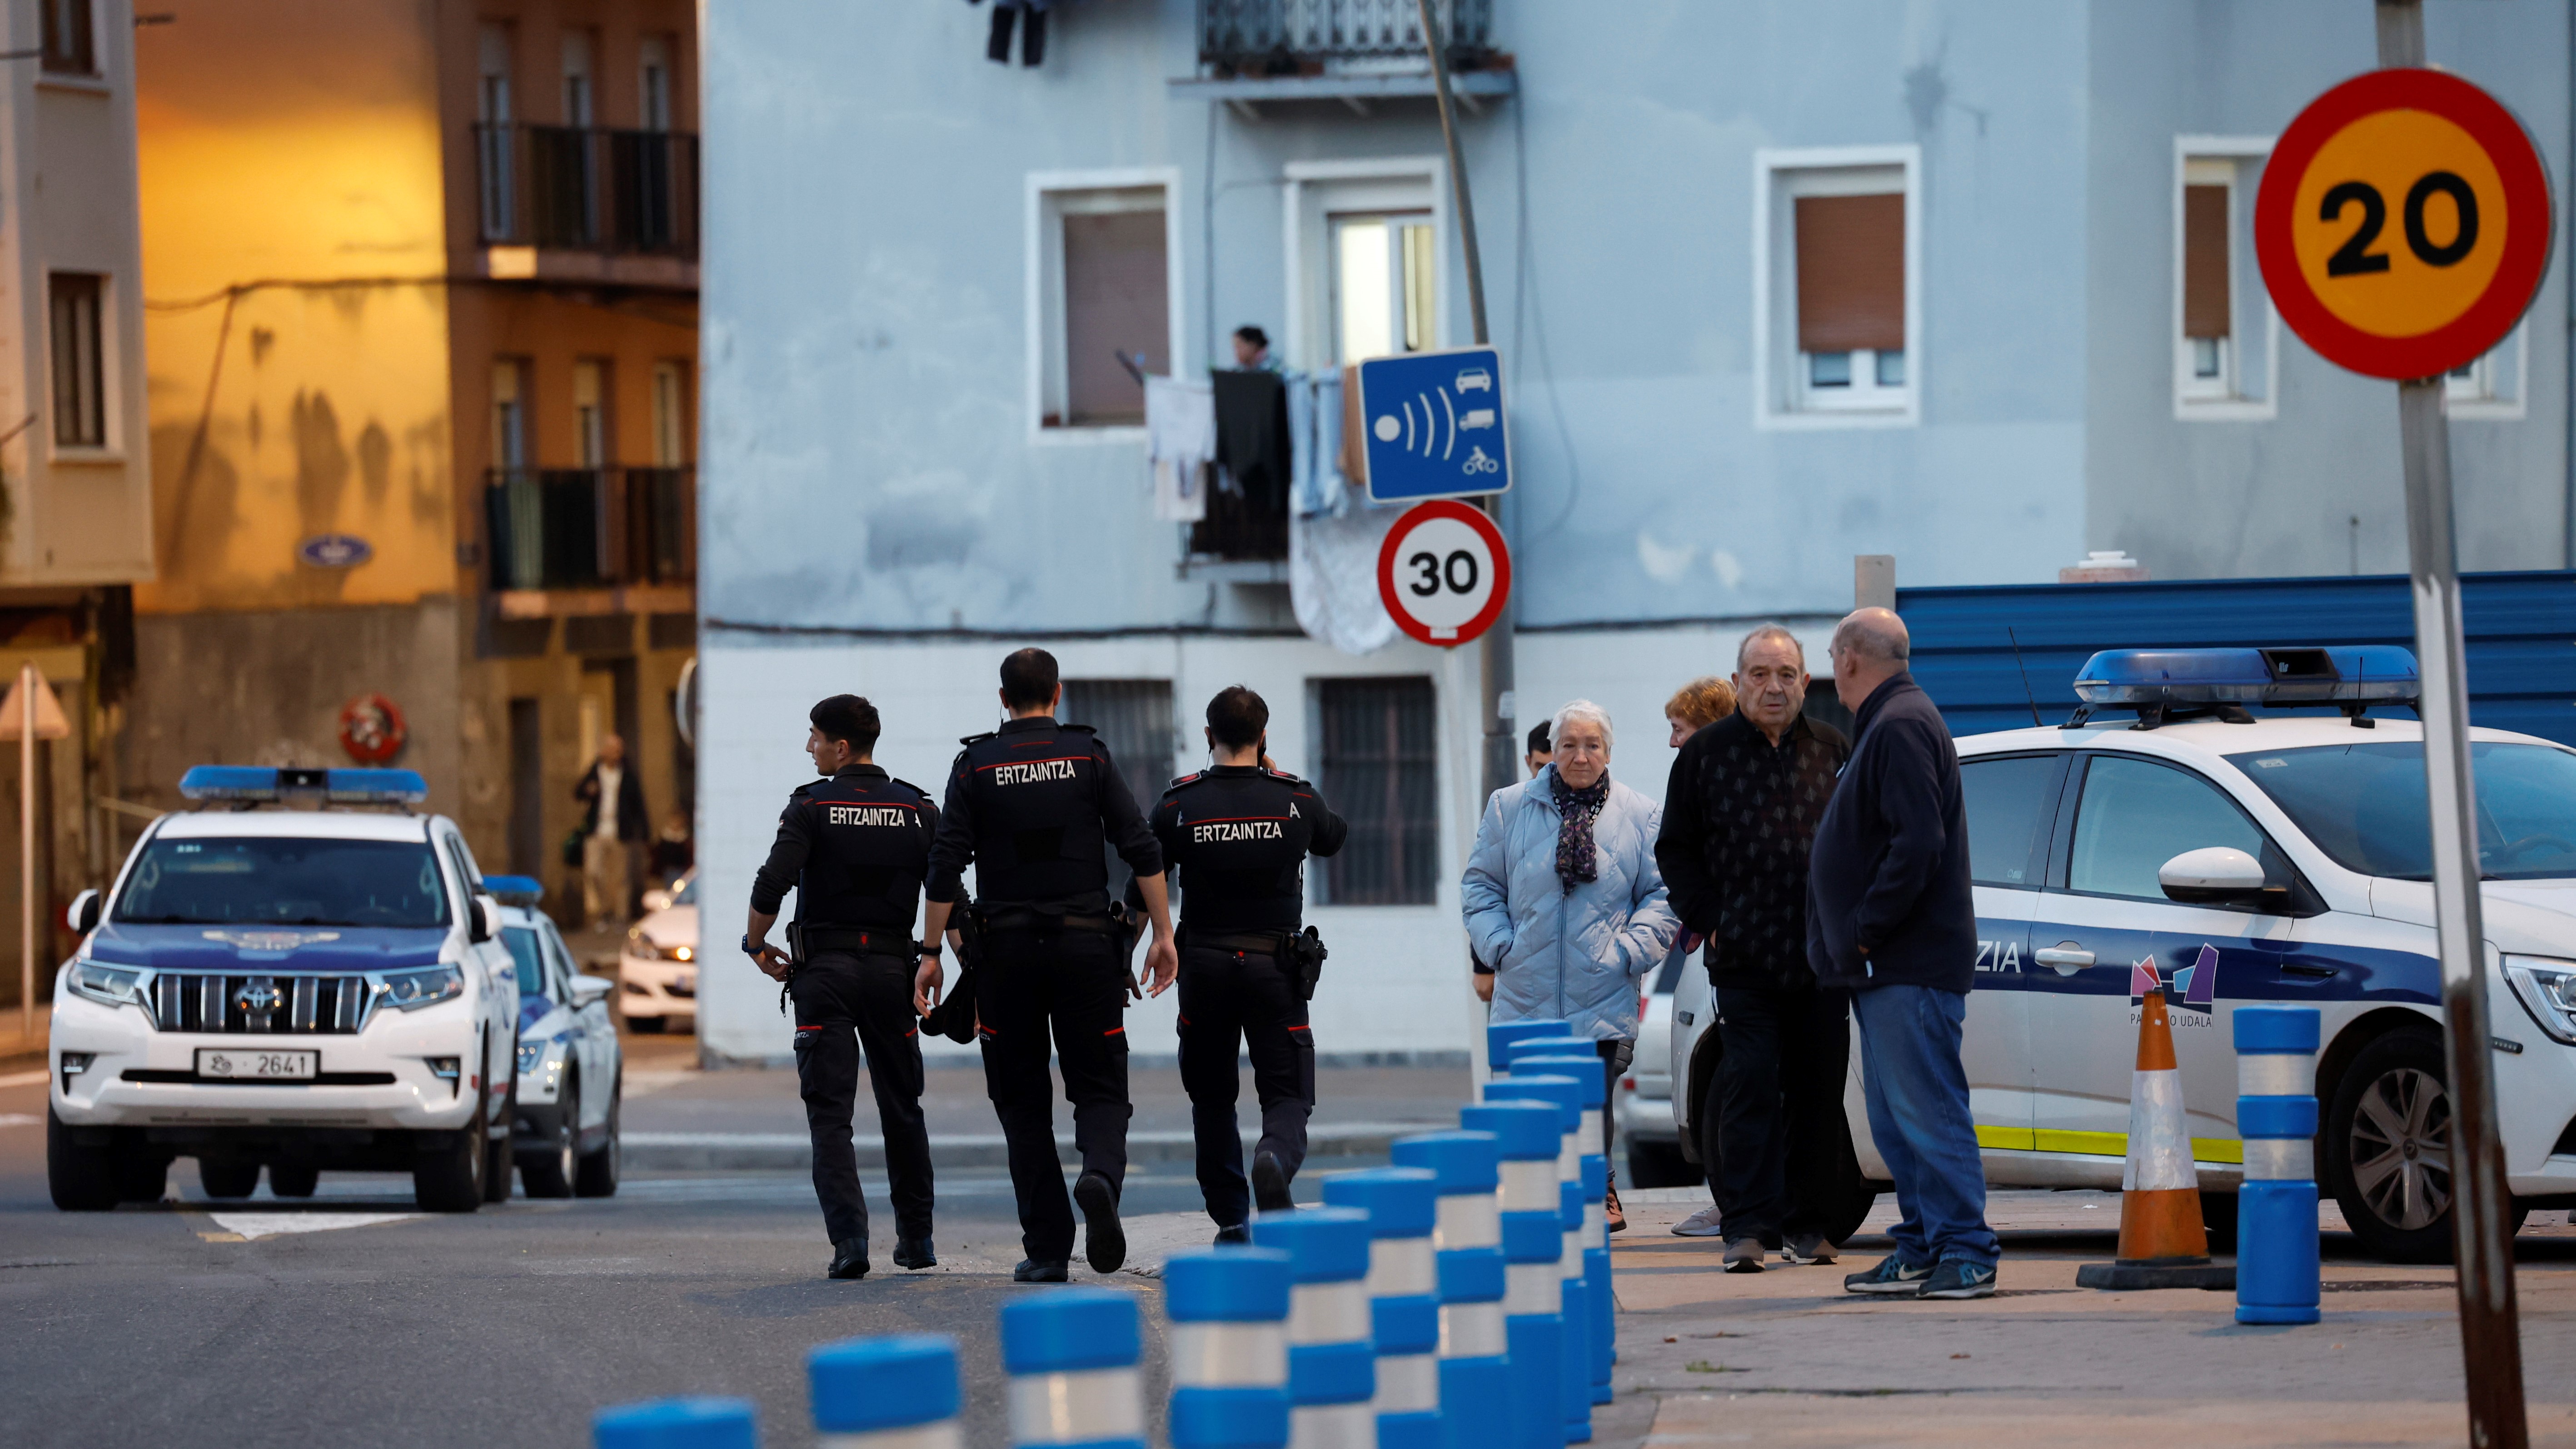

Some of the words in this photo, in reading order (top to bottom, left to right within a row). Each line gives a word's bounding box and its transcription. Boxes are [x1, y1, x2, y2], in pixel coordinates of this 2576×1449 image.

[2320, 170, 2479, 279] 20
[1409, 550, 1478, 597] 30
[995, 760, 1076, 786] ERTZAINTZA
[830, 807, 905, 827] ERTZAINTZA
[1193, 822, 1283, 843] ERTZAINTZA
[2181, 1016, 2212, 1027] UDALA
[258, 1054, 306, 1076] 2641
